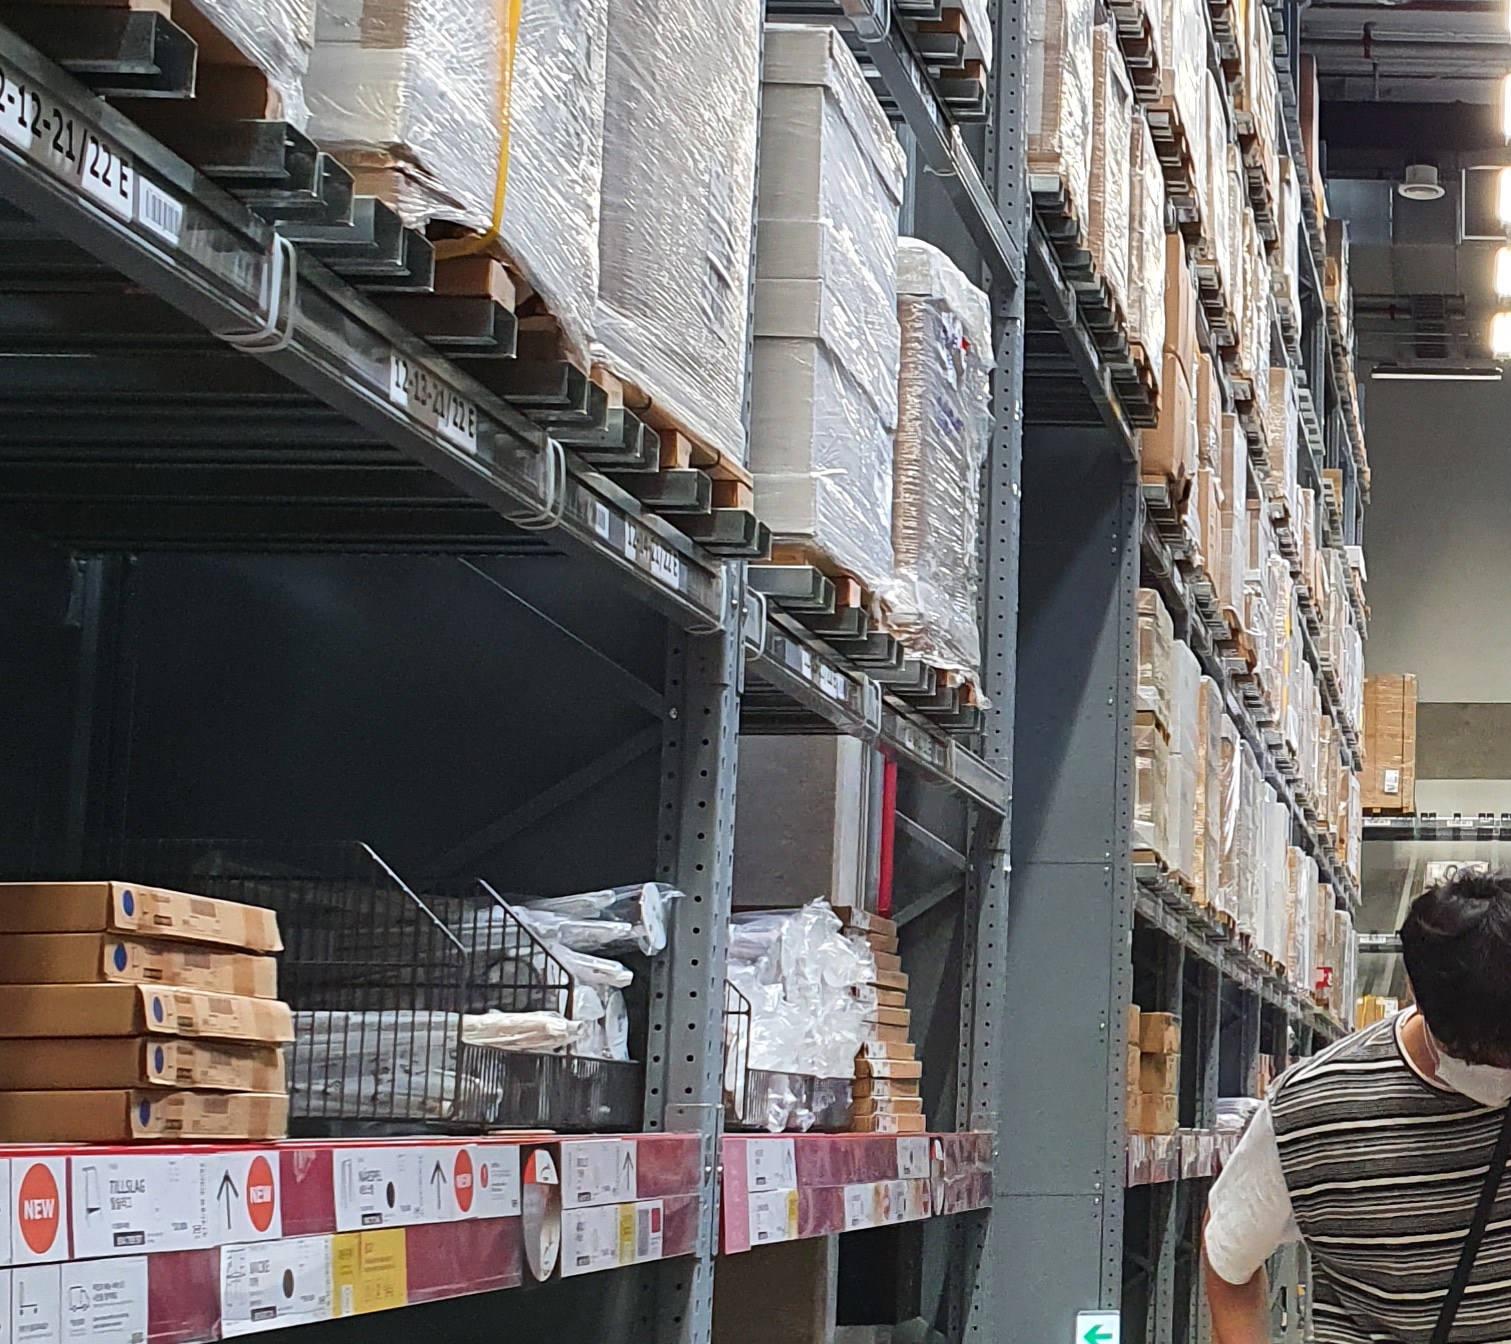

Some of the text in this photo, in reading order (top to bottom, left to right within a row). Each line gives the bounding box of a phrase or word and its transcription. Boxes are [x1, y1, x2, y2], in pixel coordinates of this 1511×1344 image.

[120, 157, 129, 200] E
[395, 358, 475, 439] 12-13-21/22 E
[23, 1199, 55, 1220] NEW
